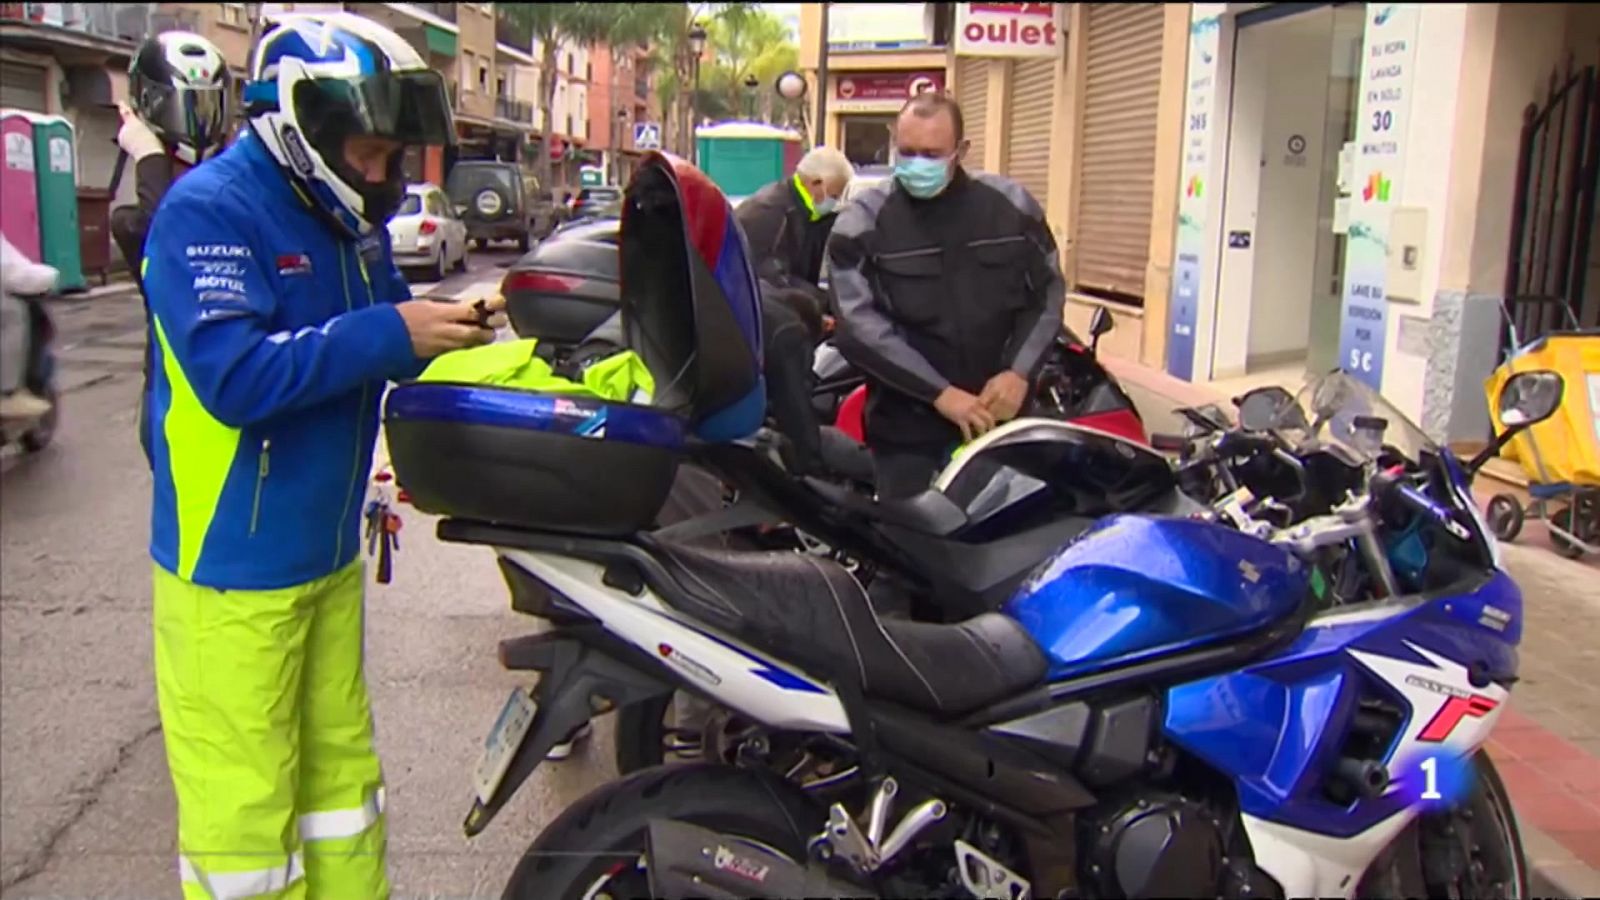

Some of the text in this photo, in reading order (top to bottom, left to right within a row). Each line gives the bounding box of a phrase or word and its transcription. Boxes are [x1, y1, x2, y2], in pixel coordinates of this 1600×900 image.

[964, 19, 1056, 46] oulet
[1372, 110, 1393, 132] 30
[186, 245, 251, 257] SUZUKI
[193, 276, 246, 292] MOTUL
